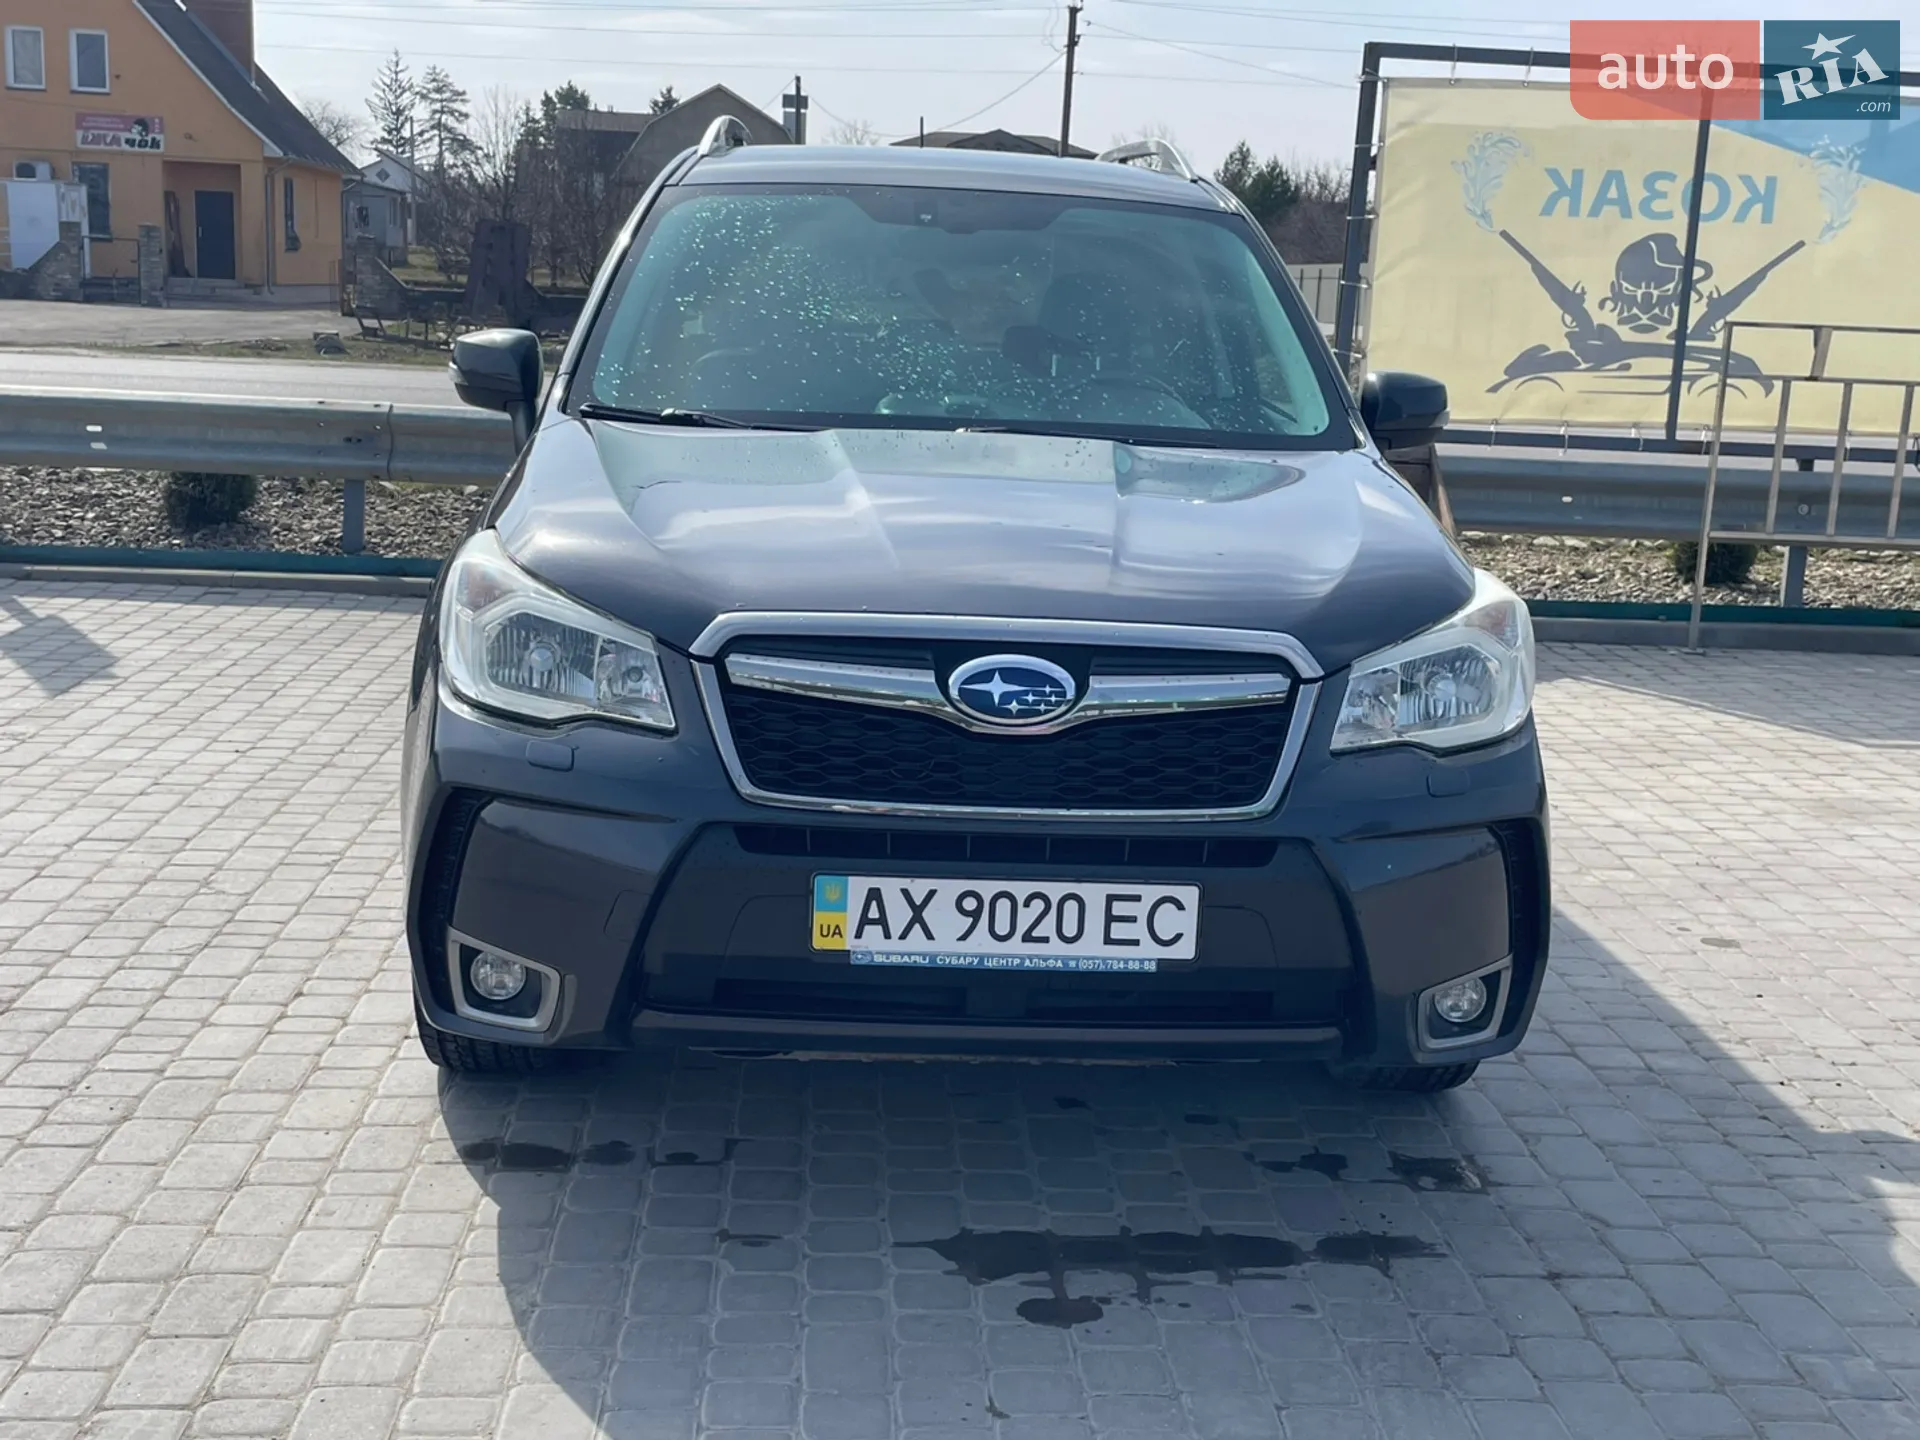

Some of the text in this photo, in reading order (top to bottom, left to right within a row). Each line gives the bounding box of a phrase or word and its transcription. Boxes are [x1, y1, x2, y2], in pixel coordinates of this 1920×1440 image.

[854, 886, 1187, 947] AX 9020 EC
[819, 924, 844, 939] UA
[873, 953, 930, 964] SUBARU
[936, 954, 980, 966] СУБАРУ
[984, 957, 1021, 968] ЦЕНТР
[1024, 958, 1063, 969] АЛЬФА
